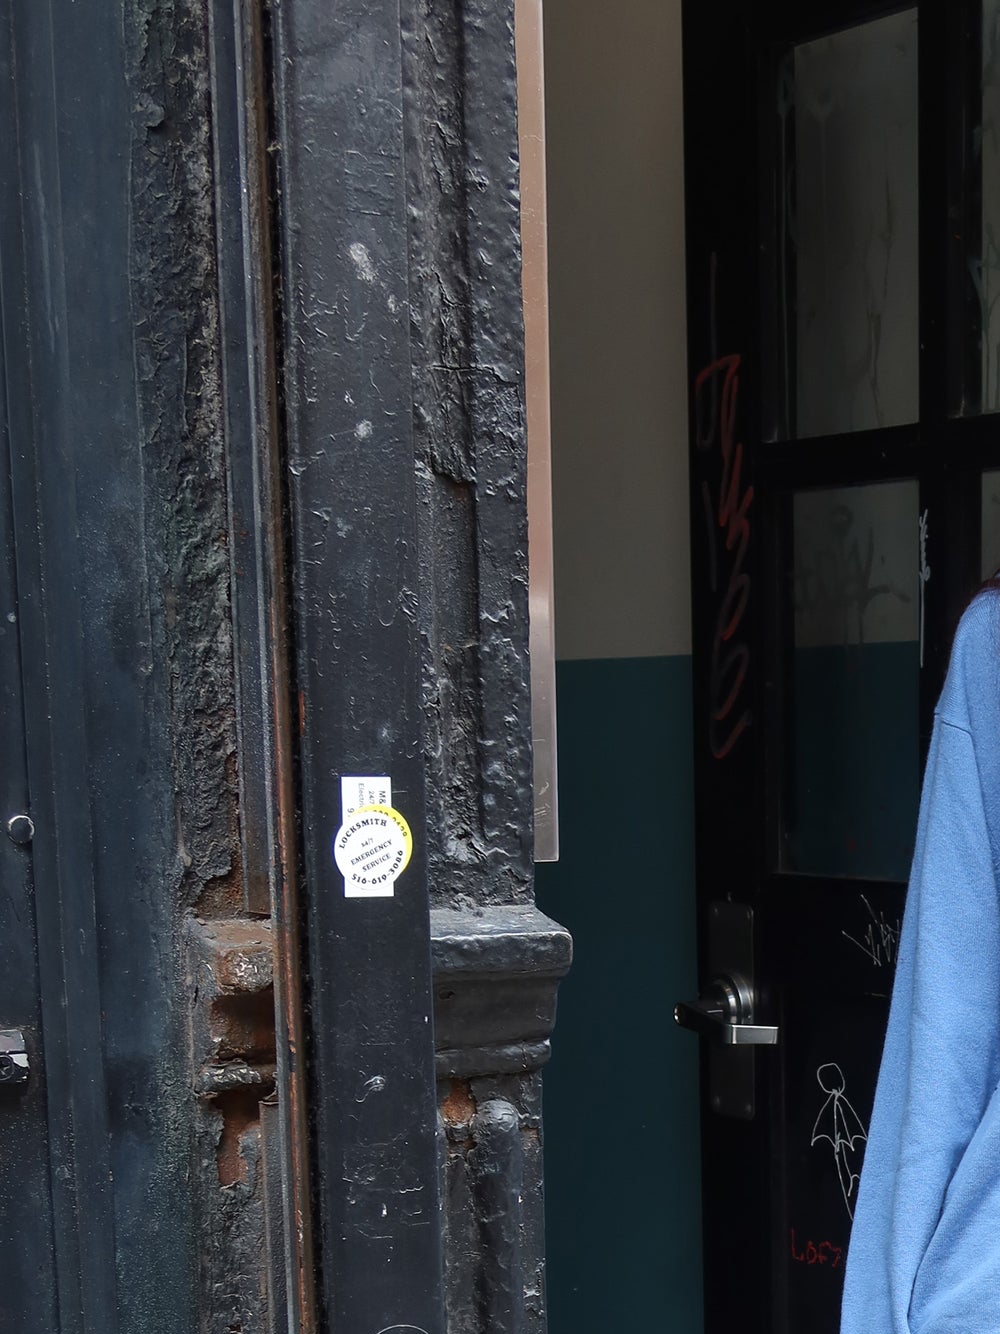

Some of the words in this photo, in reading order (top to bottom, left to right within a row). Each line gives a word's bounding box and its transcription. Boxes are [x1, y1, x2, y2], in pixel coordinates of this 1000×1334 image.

[338, 818, 388, 849] LOCKSMITH
[350, 839, 393, 866] EMERGENCY
[361, 852, 391, 873] SERVICE
